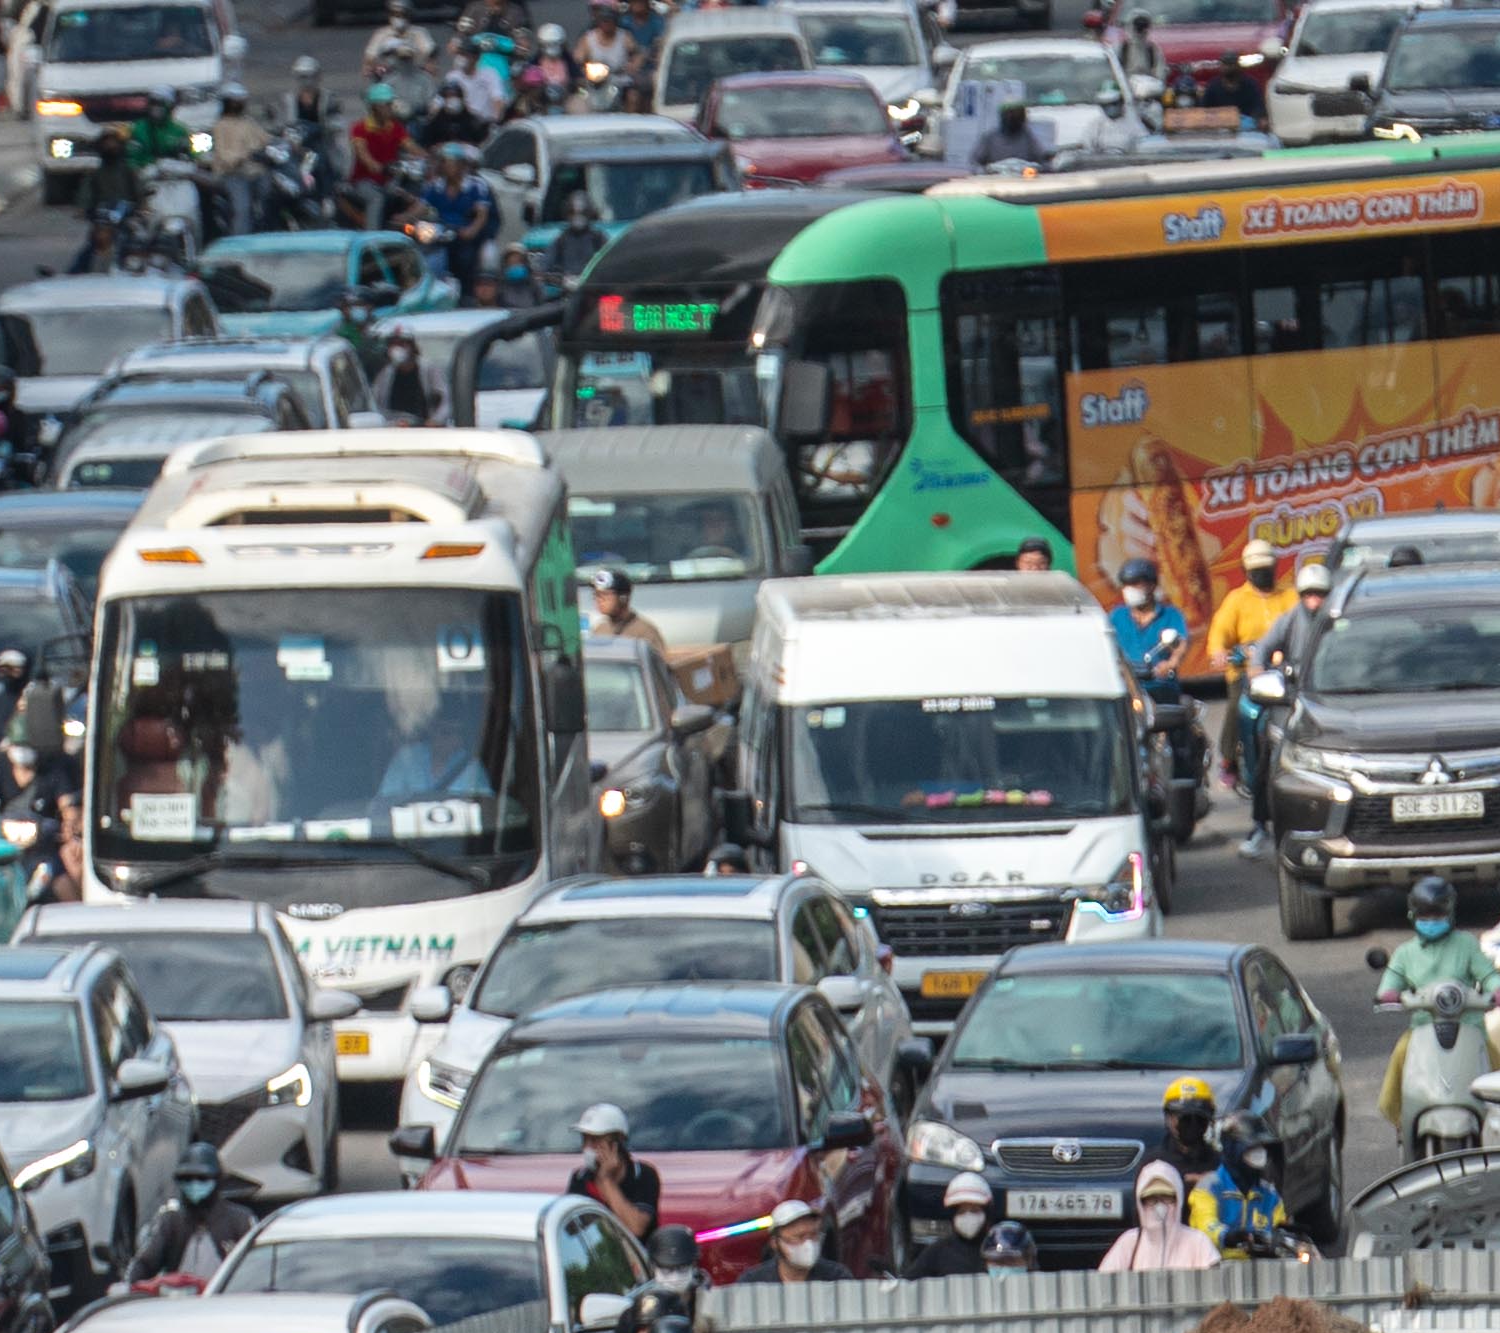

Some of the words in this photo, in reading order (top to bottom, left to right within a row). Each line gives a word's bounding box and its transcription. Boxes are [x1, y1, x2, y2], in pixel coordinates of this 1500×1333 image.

[1283, 199, 1359, 226] TOANG
[1080, 387, 1149, 427] Staff
[1254, 451, 1354, 496] TOANG
[324, 934, 457, 961] VIETNAM
